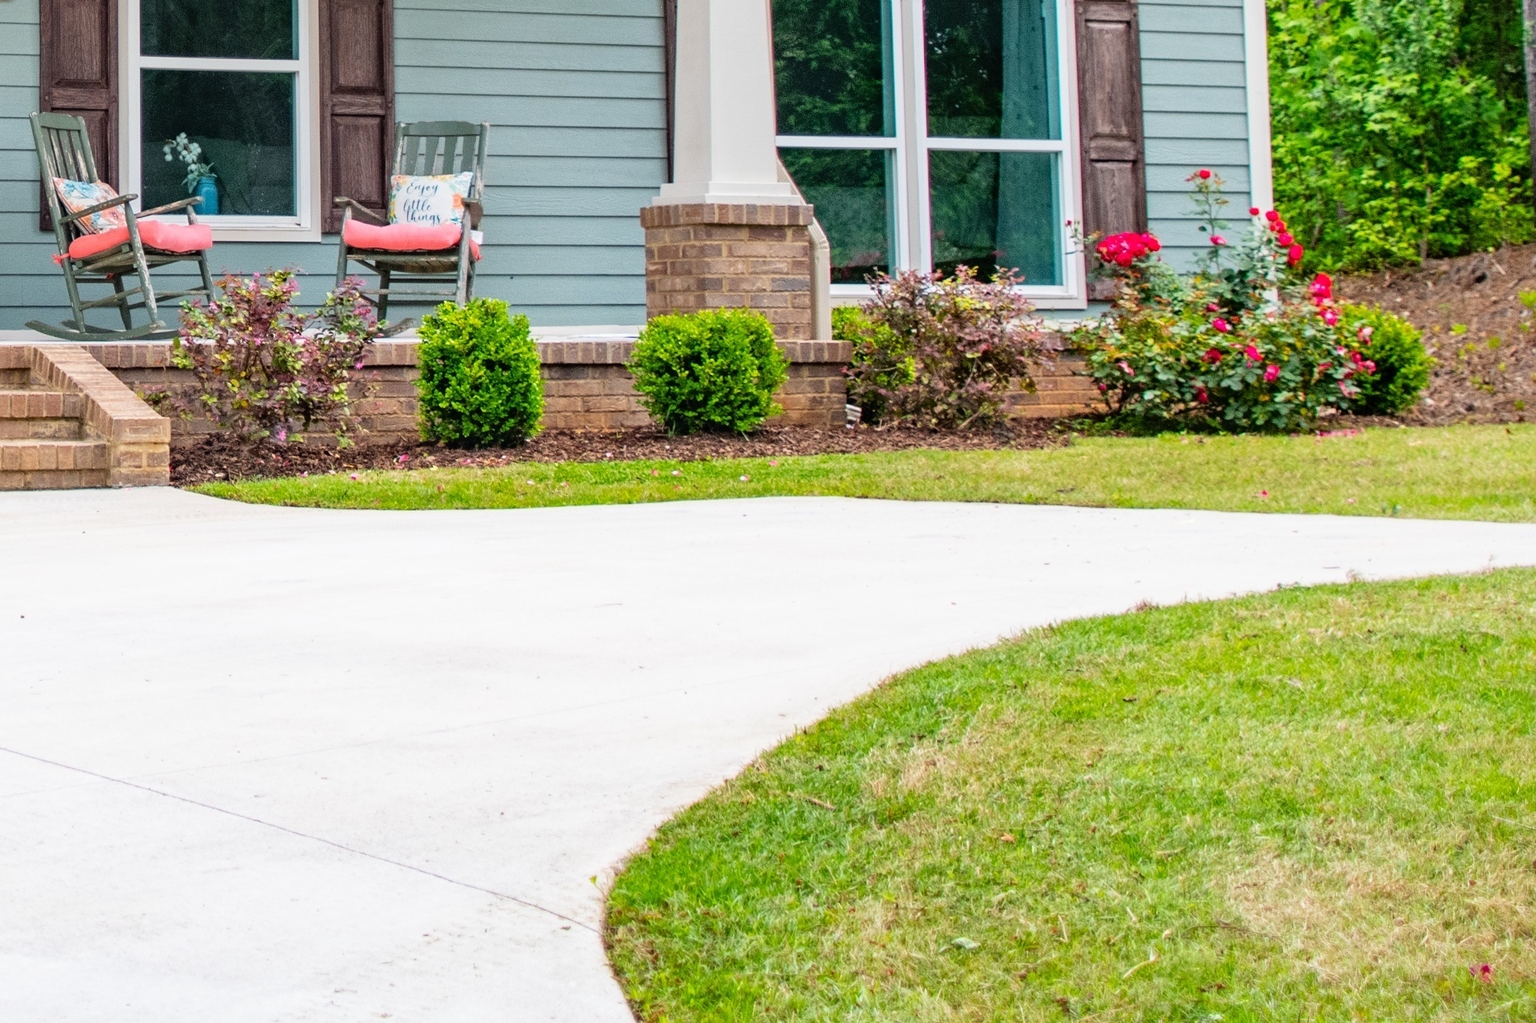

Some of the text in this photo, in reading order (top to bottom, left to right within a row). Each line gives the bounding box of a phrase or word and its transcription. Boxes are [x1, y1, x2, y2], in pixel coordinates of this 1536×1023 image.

[407, 182, 439, 197] Enjoy
[403, 199, 431, 212] little
[406, 210, 441, 227] things
